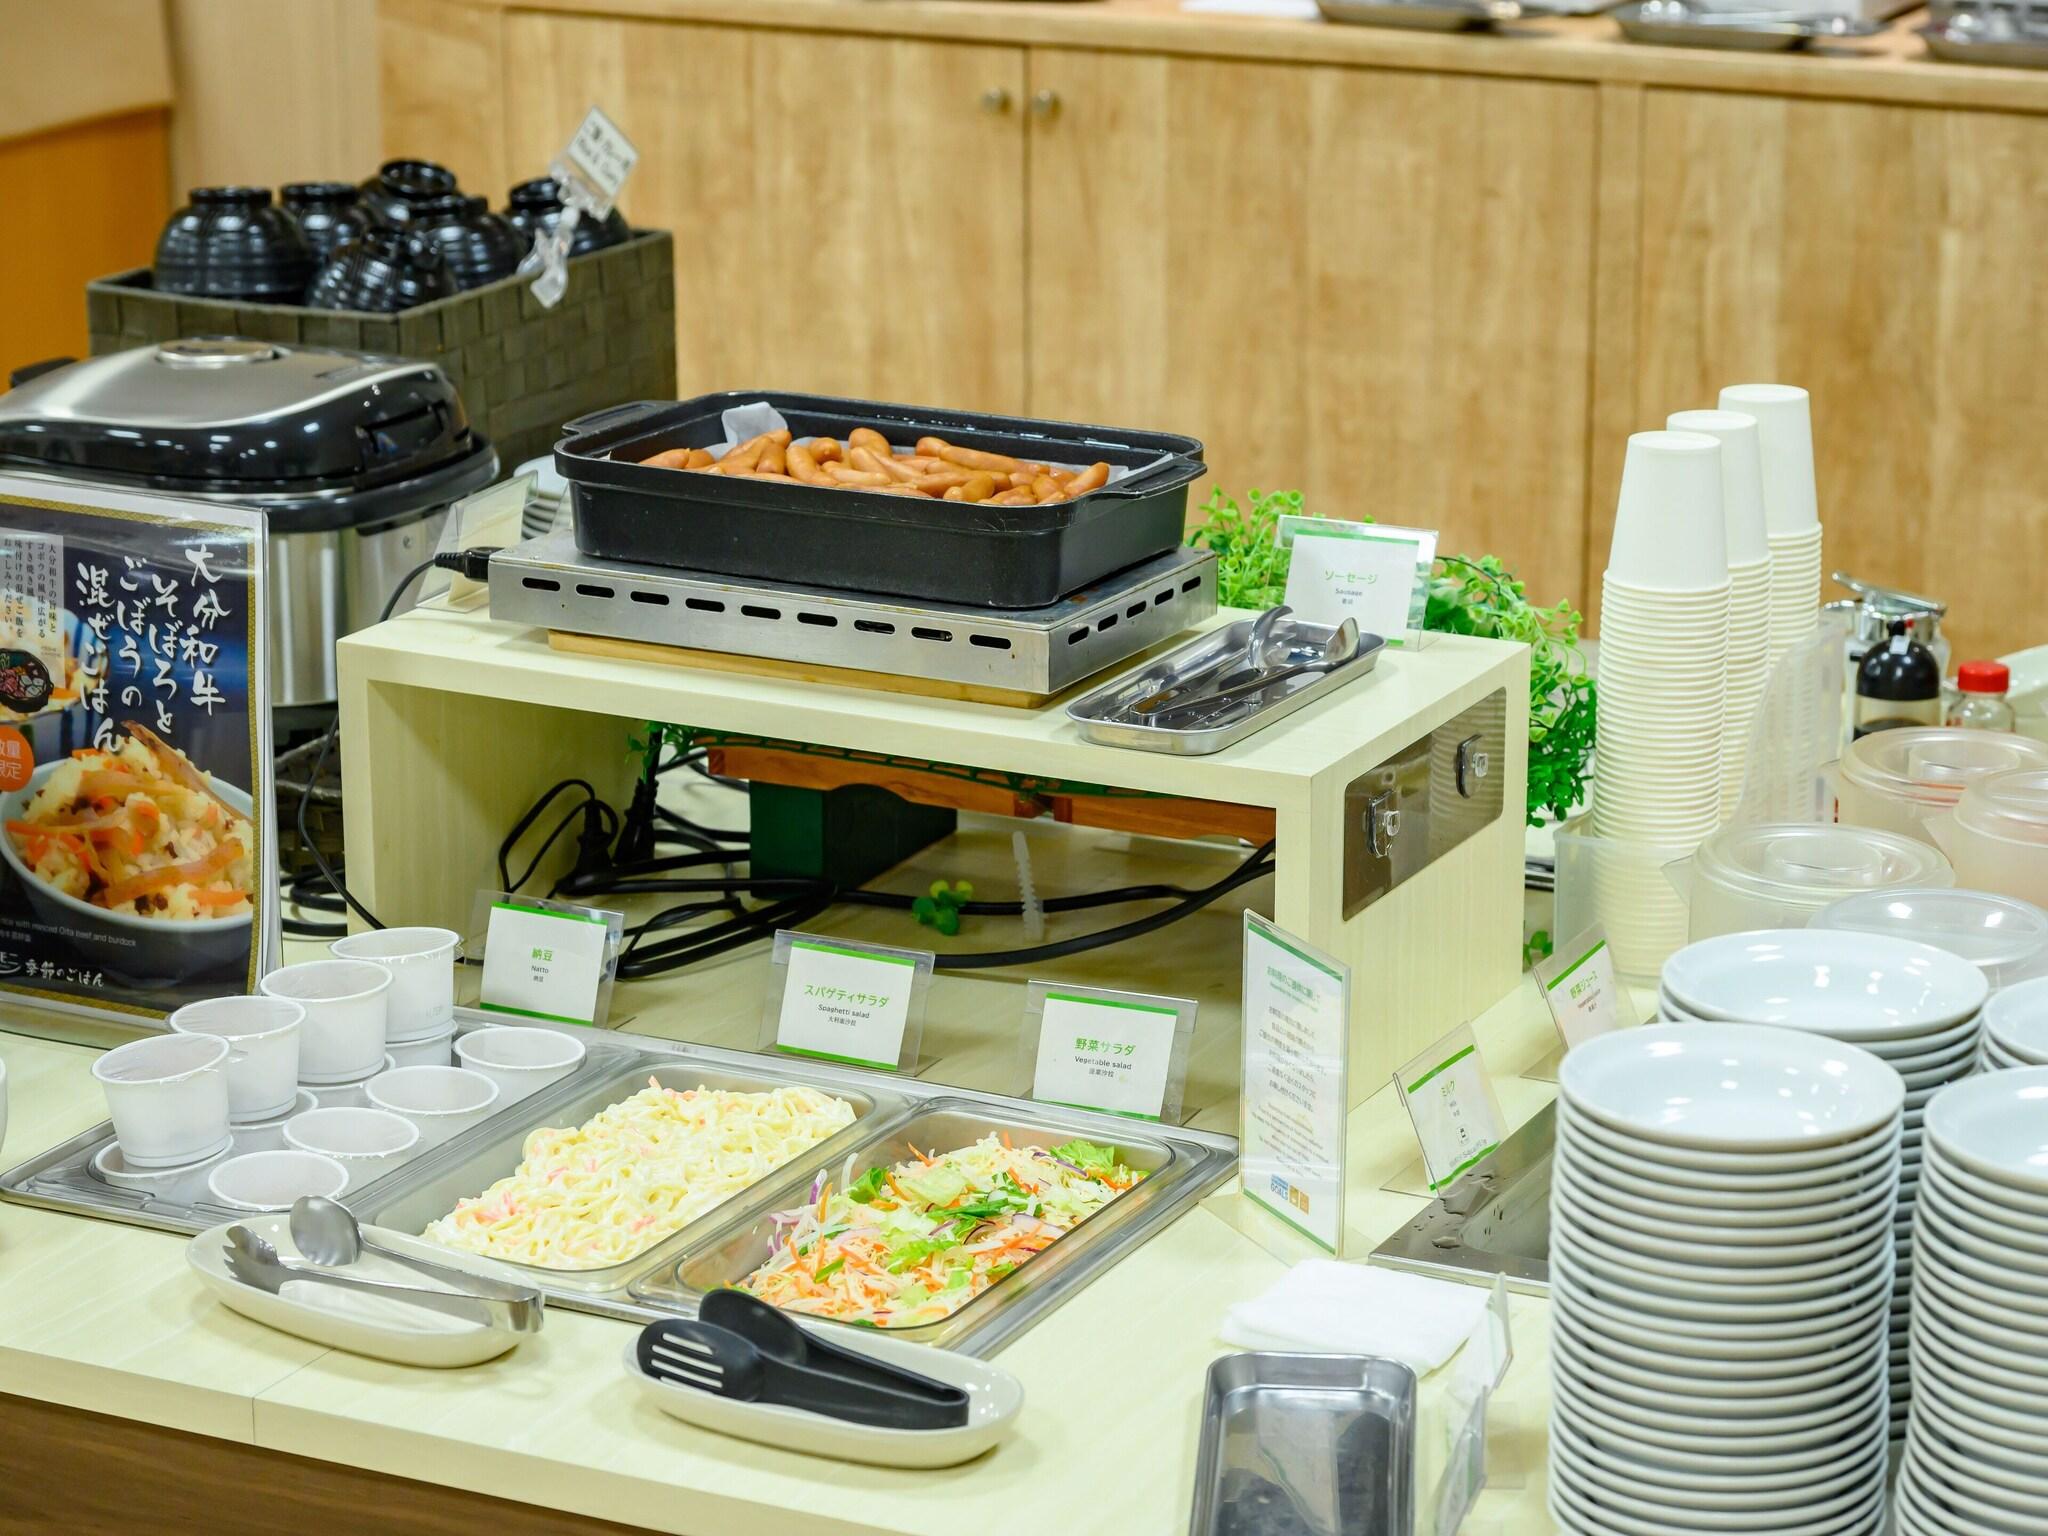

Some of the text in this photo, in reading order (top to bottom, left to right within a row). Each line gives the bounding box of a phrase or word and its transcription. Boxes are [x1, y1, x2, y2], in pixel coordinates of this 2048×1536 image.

[1324, 569, 1378, 585] ソーセージ
[117, 555, 150, 707] ごぼうの
[180, 544, 232, 716] 大分和牛
[75, 562, 120, 753] 混ぜごはん
[149, 574, 183, 734] そぼろと
[531, 947, 553, 962] 納豆
[25, 958, 105, 988] 季節のごはん
[531, 965, 549, 974] Natto
[804, 983, 890, 1008] スパゲティサラダ
[818, 1003, 870, 1019] Spaghetti salad
[1074, 1037, 1137, 1057] 野菜サラダ
[1075, 1055, 1132, 1070] Vegetable salad
[1270, 1182, 1289, 1201] GOALS
